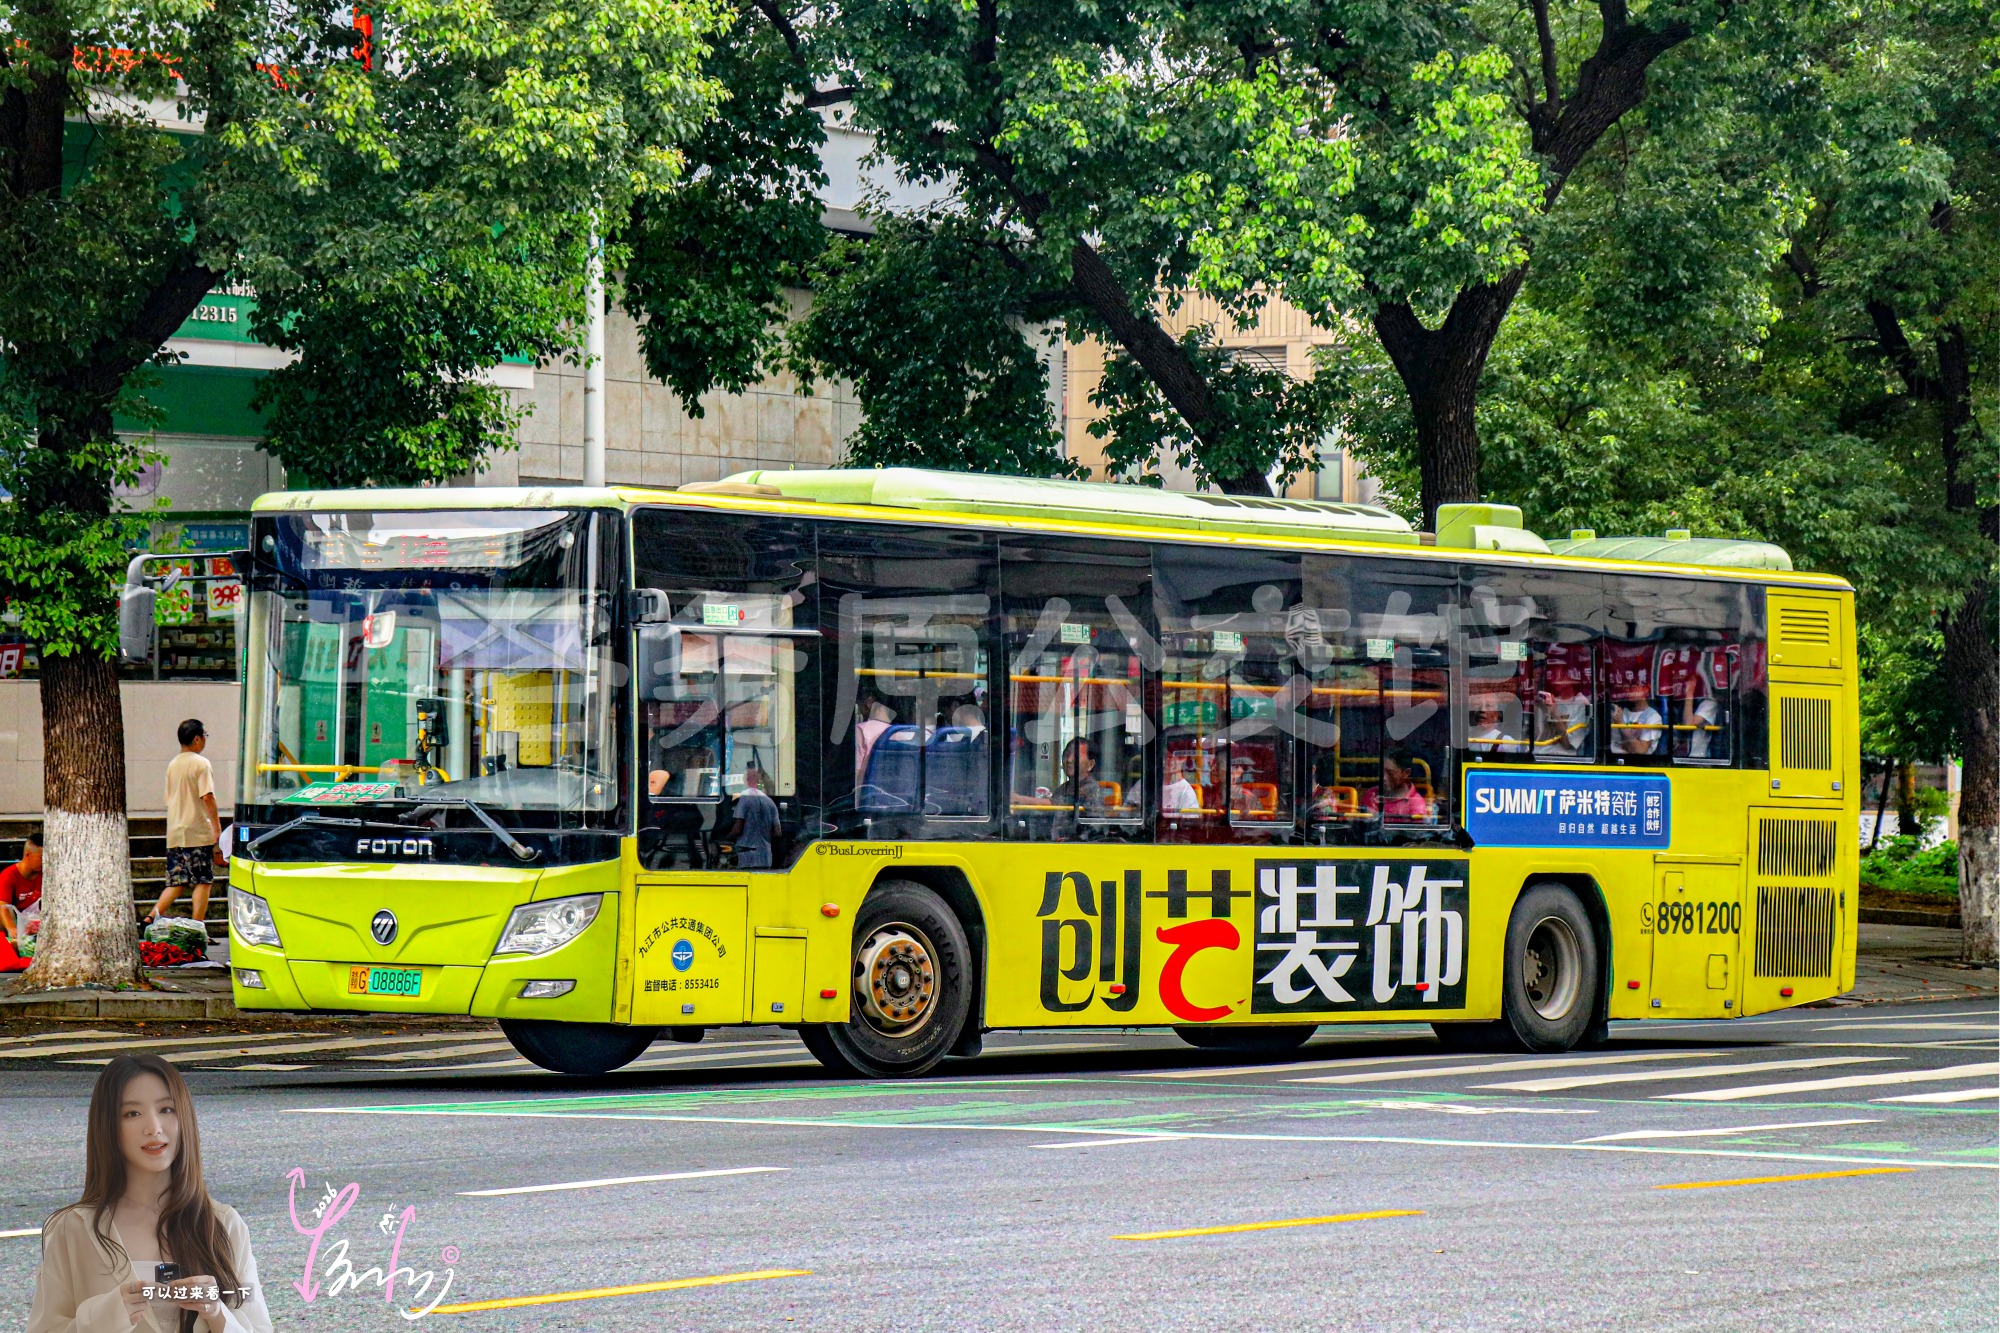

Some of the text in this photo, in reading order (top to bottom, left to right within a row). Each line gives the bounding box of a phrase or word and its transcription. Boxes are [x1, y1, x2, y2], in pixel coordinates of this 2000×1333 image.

[191, 305, 238, 322] 12315
[1475, 787, 1638, 816] SUMMIT 萨米特瓷砖
[1646, 795, 1660, 807] 创艺
[1646, 807, 1660, 819] 合作
[1558, 822, 1637, 835] 回归自然 超越生活
[1646, 819, 1660, 831] 伙伴
[356, 838, 433, 855] FOTON
[1657, 901, 1741, 934] 8981200
[638, 916, 727, 959] 九江市公共交通集团公司
[1036, 865, 1464, 1022] 创艺装饰
